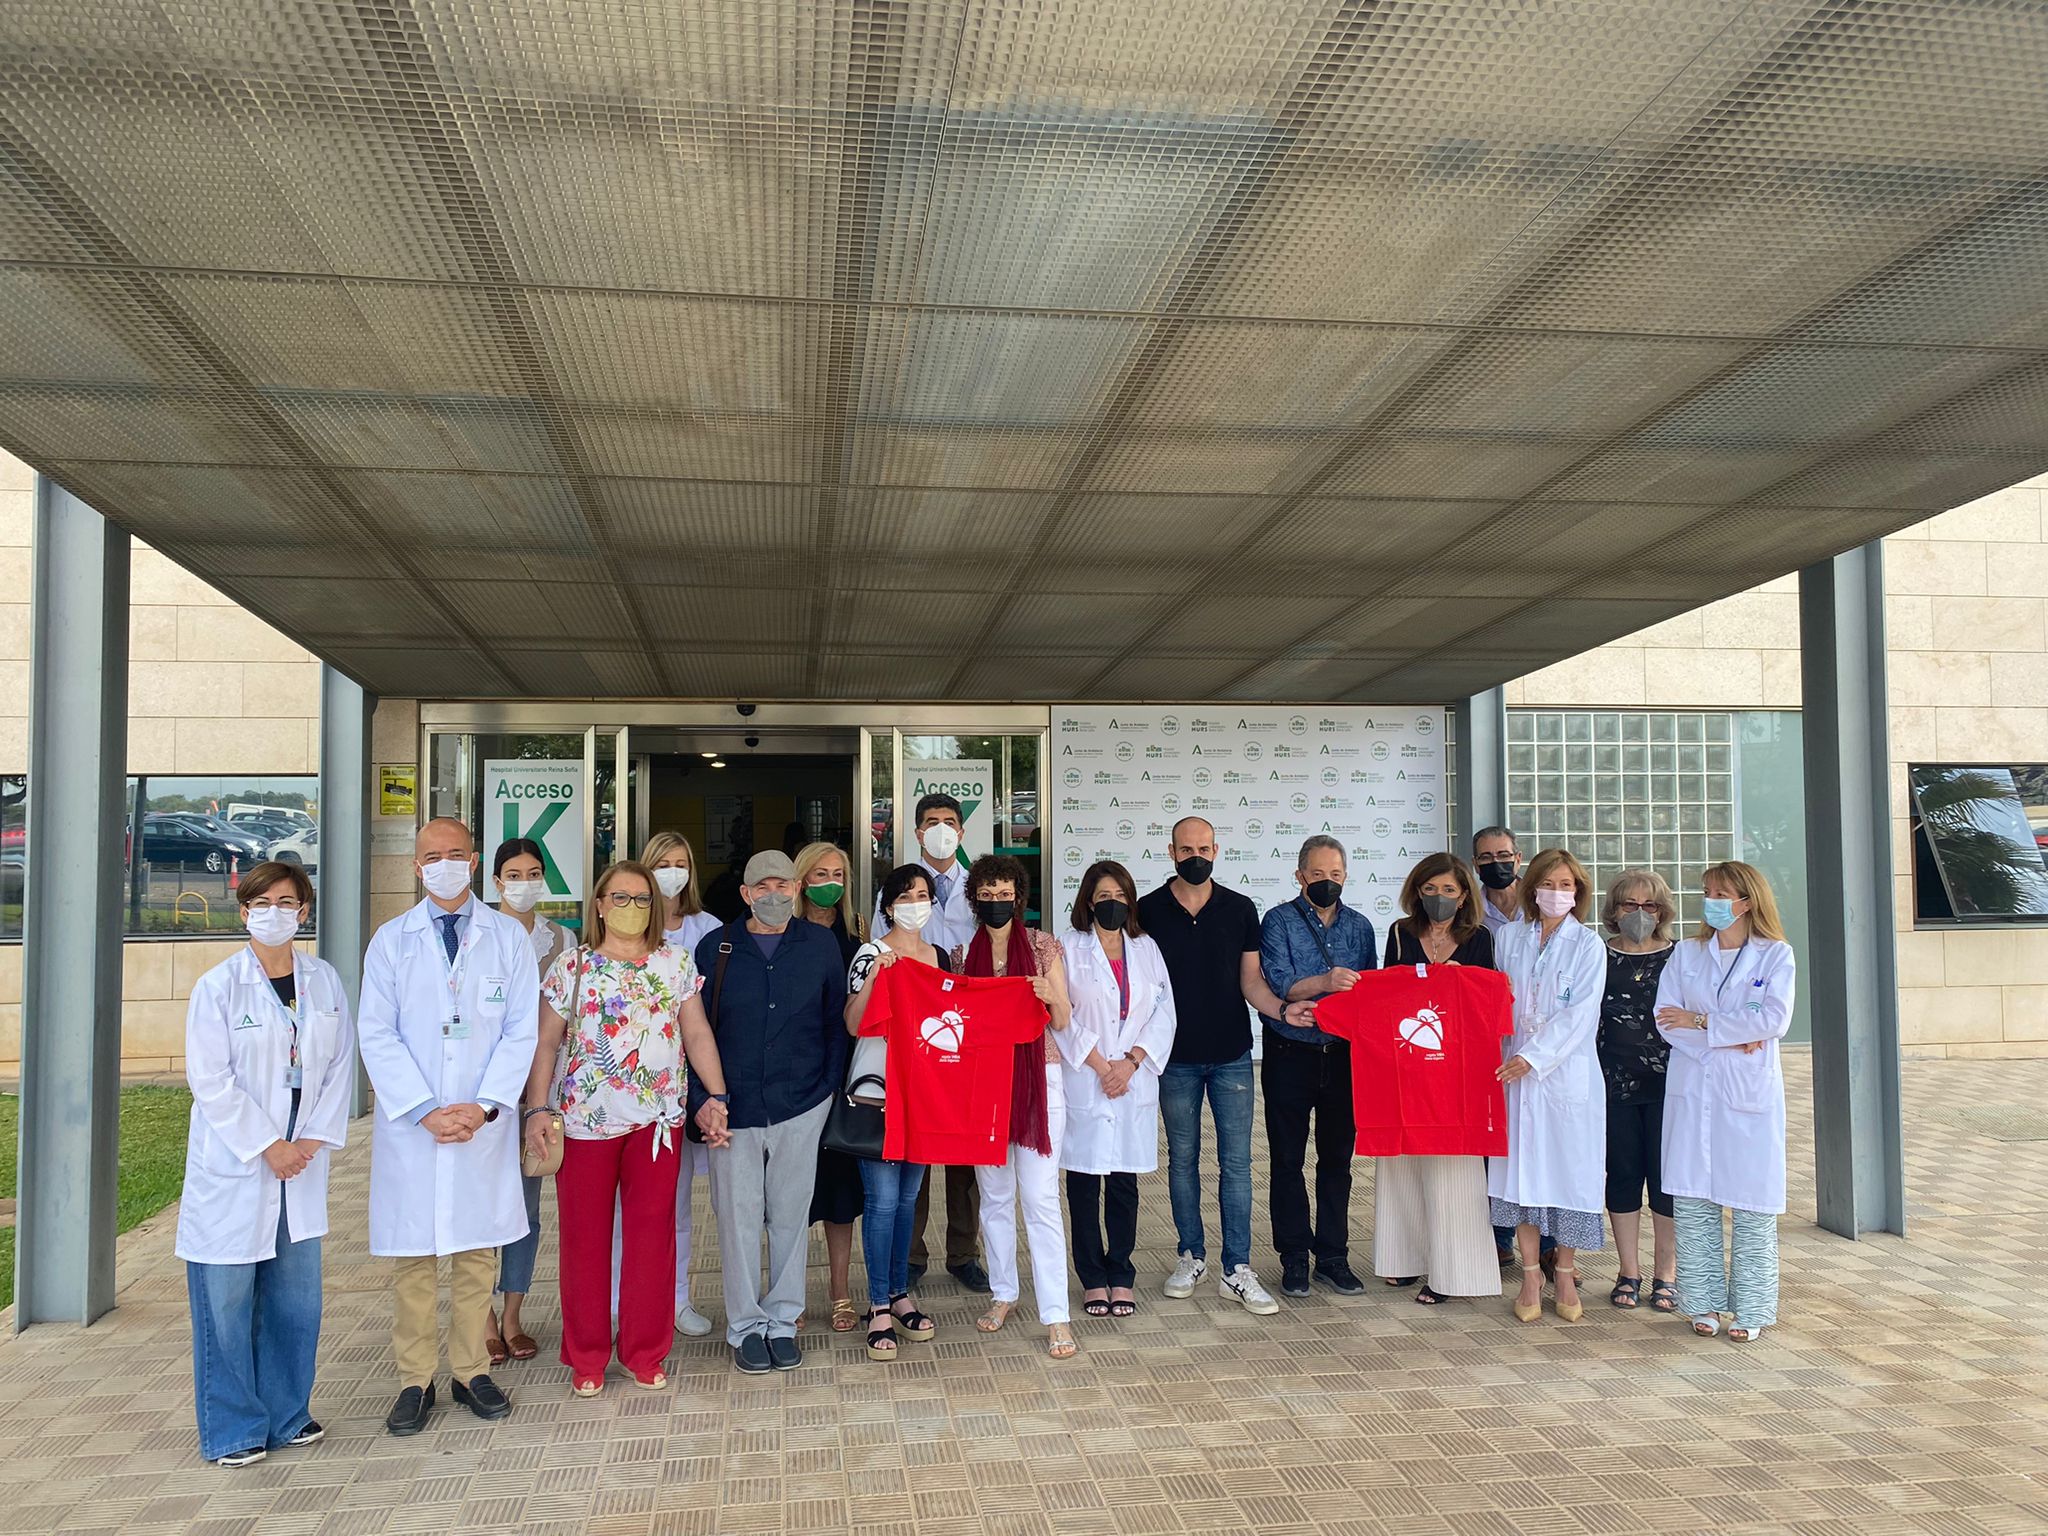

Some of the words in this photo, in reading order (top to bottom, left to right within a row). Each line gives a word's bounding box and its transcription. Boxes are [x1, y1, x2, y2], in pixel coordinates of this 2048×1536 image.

[495, 779, 573, 798] Acceso
[913, 778, 983, 797] Acceso
[503, 802, 572, 894] K
